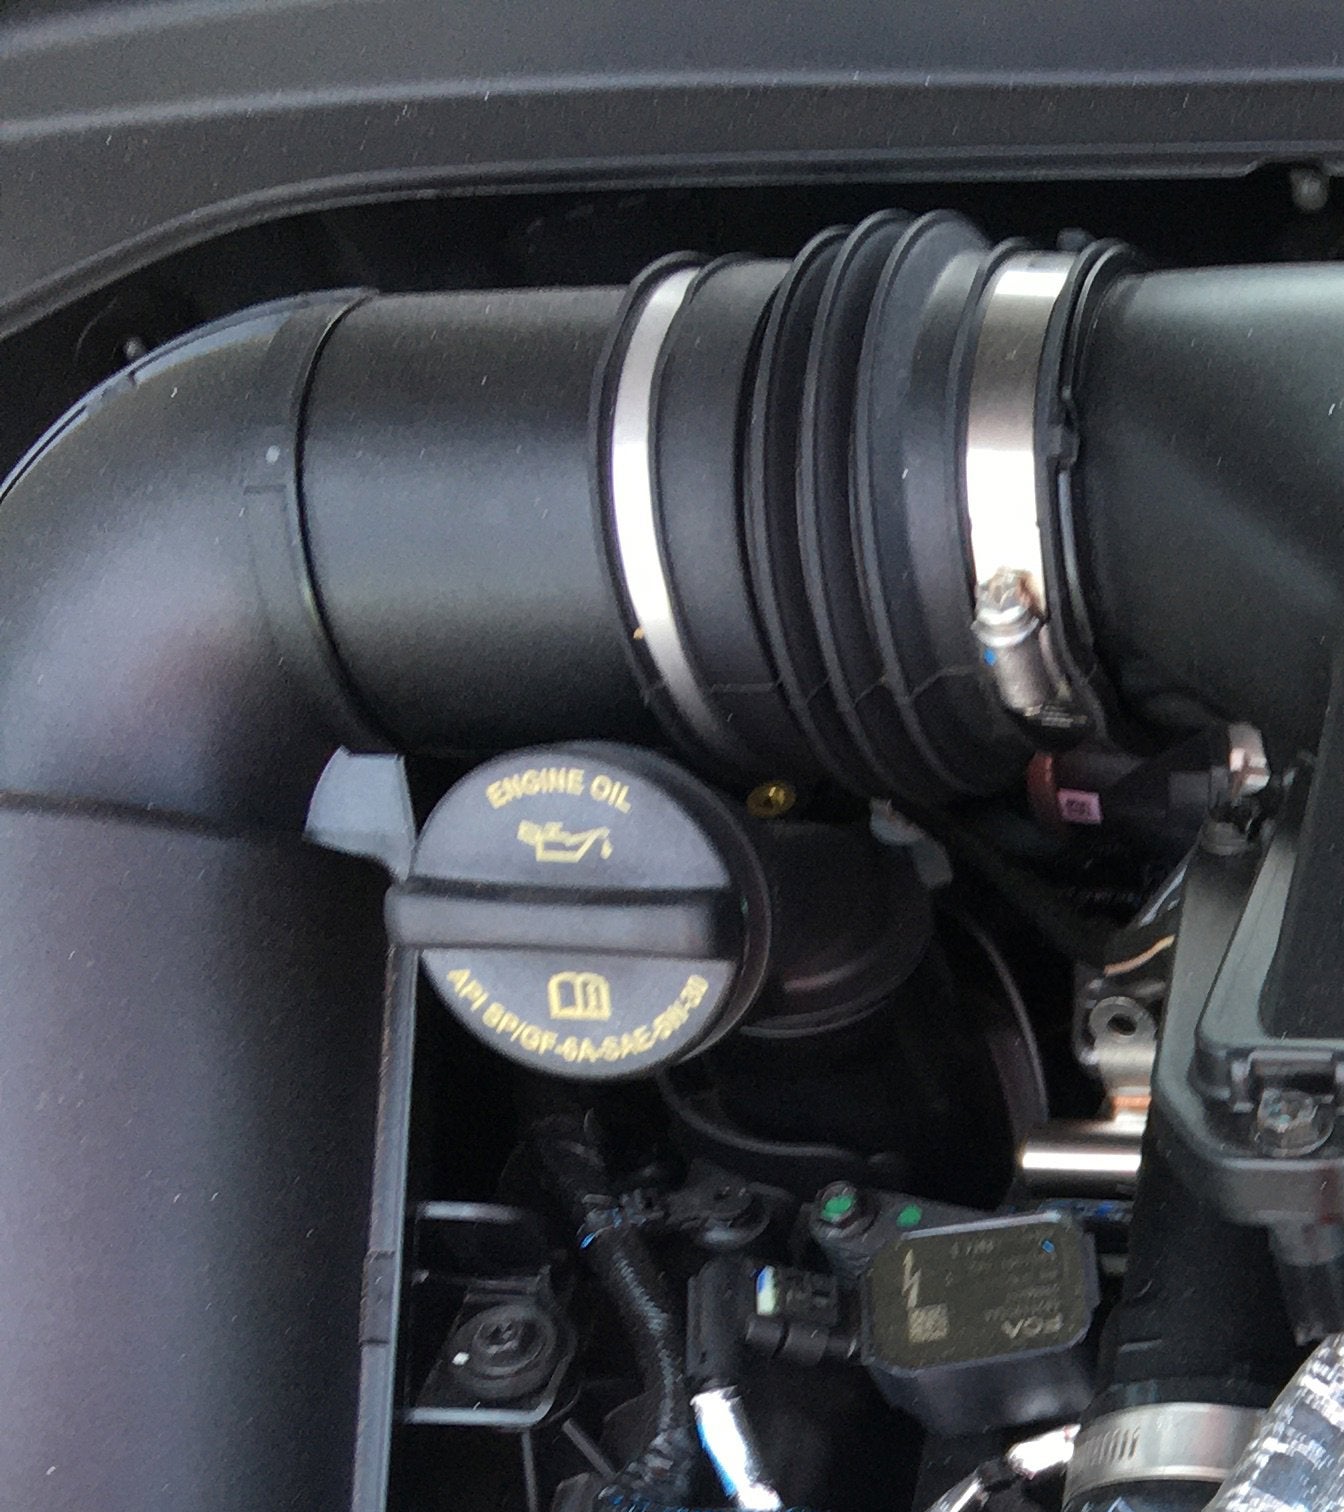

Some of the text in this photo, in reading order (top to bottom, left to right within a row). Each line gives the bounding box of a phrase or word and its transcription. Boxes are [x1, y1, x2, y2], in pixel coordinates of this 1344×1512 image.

[485, 767, 632, 814] ENGINE OIL
[446, 967, 490, 1012] API
